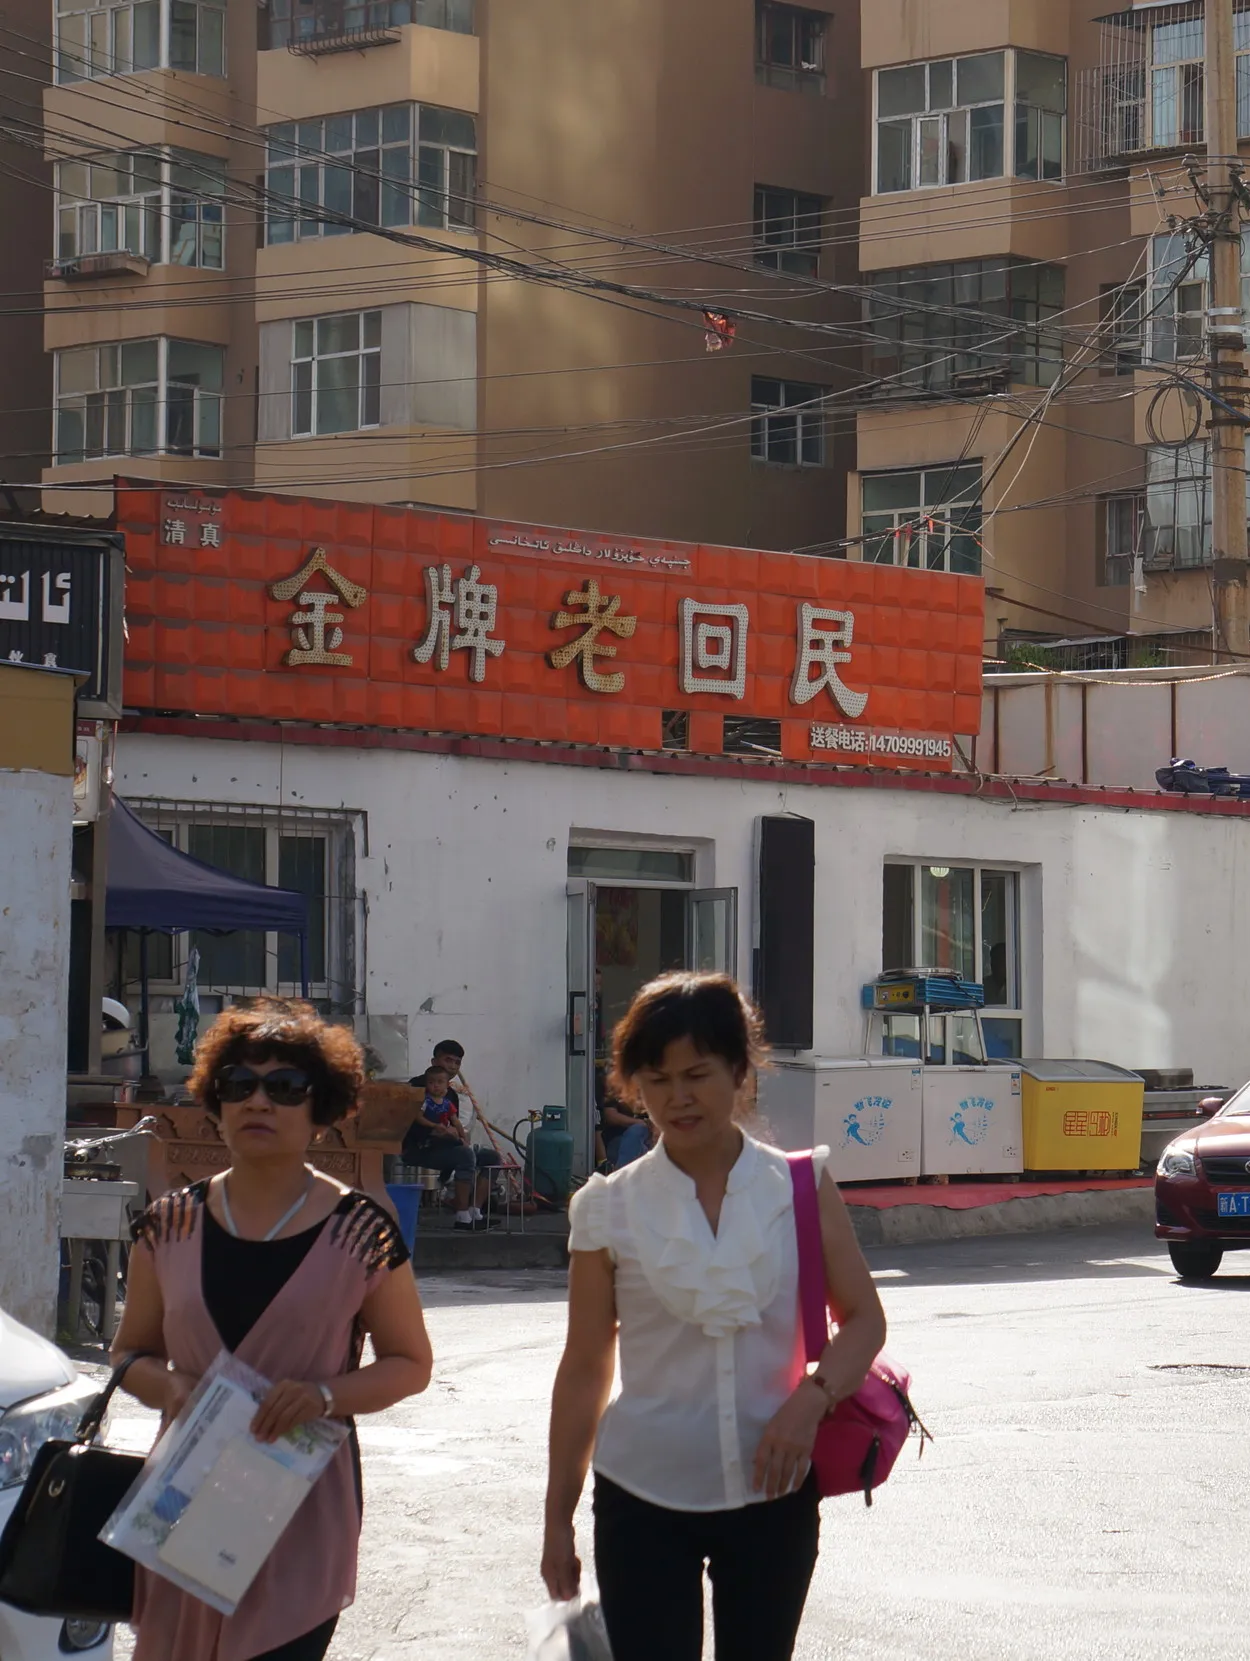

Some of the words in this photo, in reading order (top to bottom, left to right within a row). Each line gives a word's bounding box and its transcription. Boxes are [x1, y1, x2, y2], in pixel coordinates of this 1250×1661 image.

[165, 519, 220, 548] 清真
[267, 547, 869, 718] 金牌老回民
